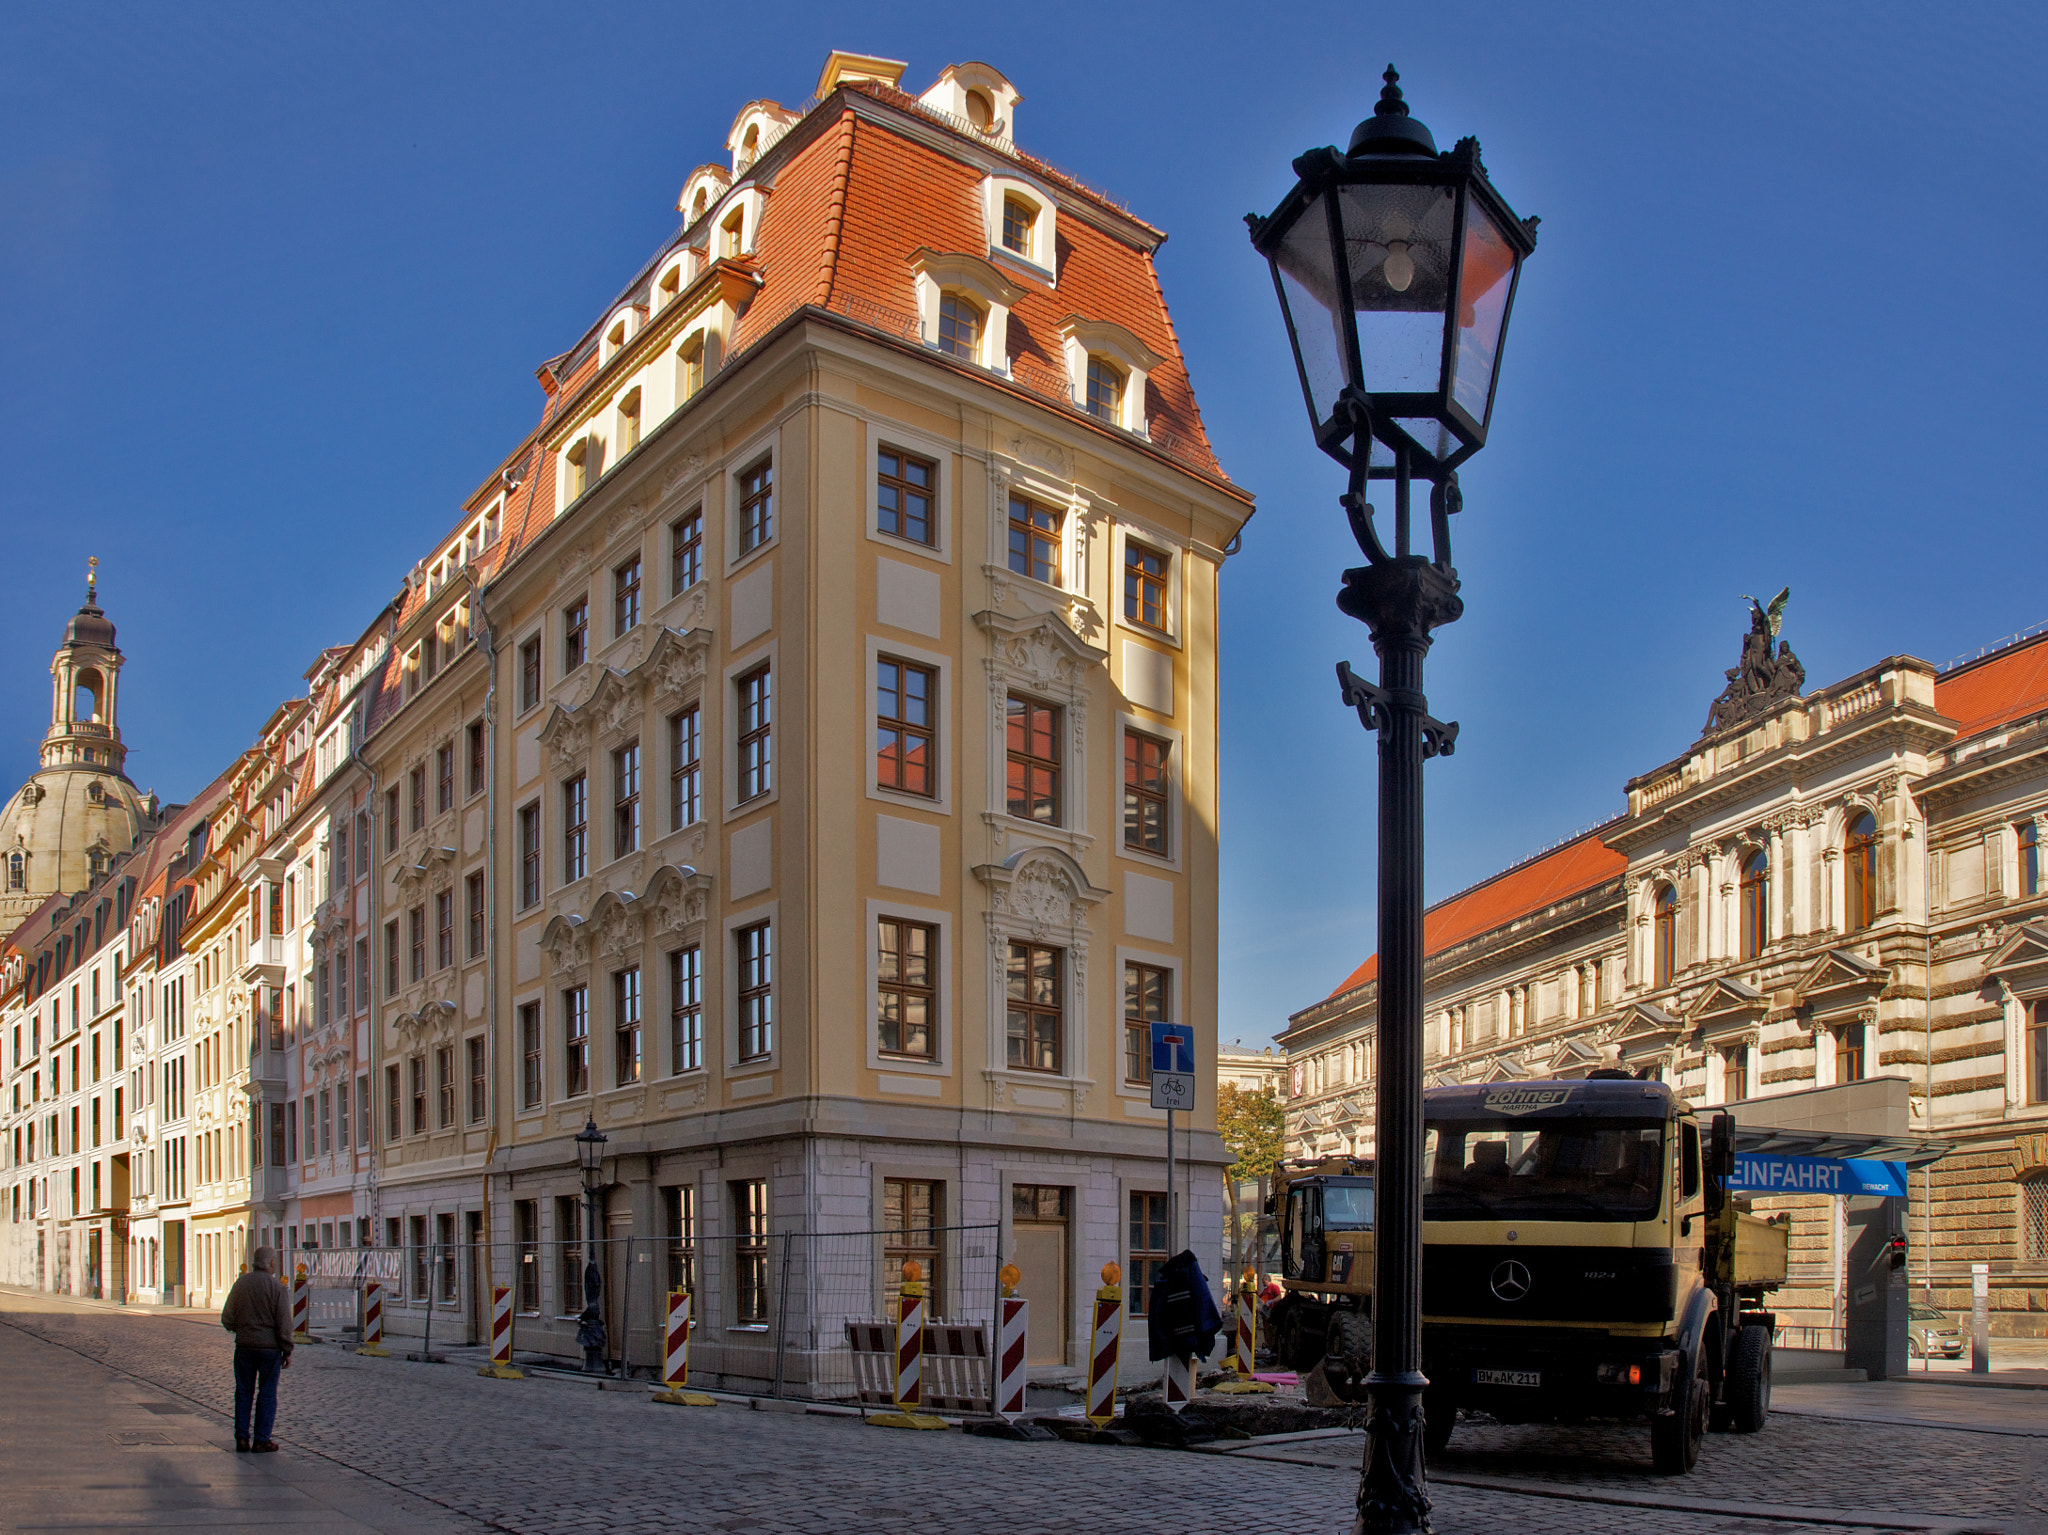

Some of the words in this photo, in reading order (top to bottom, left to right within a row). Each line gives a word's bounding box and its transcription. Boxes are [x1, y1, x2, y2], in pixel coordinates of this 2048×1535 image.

[1166, 1096, 1180, 1106] frei
[1728, 1160, 1843, 1190] EINFAHRT
[1862, 1182, 1889, 1192] BEWACHT
[1332, 1254, 1344, 1272] CAT
[1500, 1372, 1515, 1384] AK
[1517, 1373, 1538, 1386] 211
